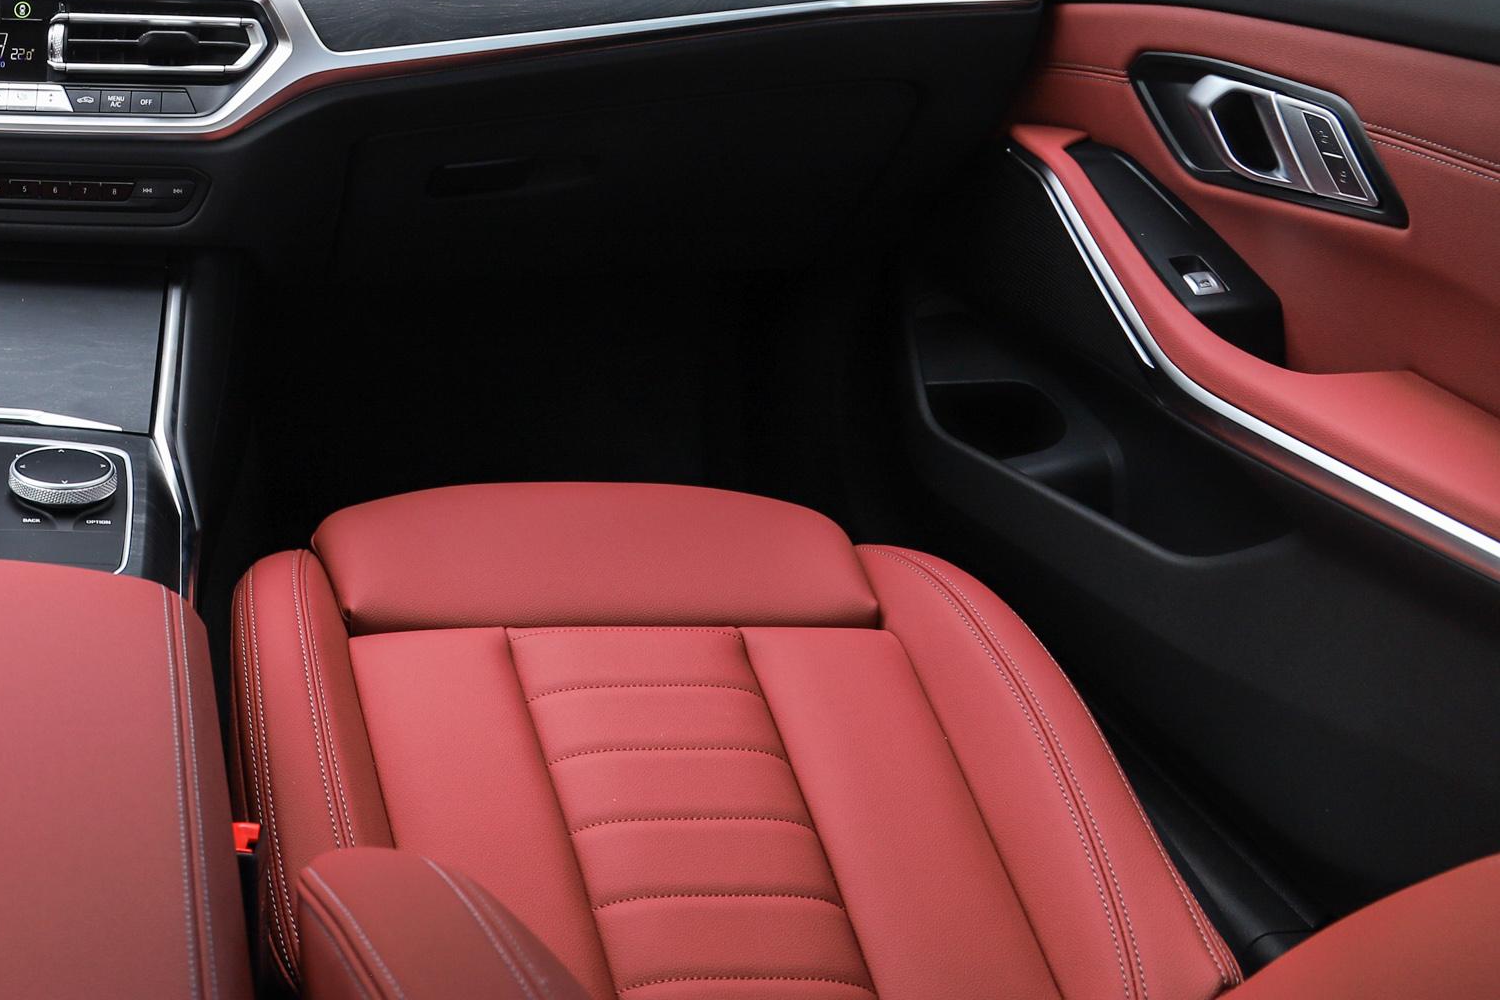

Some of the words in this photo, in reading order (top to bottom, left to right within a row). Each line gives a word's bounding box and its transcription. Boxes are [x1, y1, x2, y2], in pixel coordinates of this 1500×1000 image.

[139, 98, 153, 106] OFF
[22, 185, 27, 193] 5
[53, 186, 58, 194] 6
[83, 187, 88, 195] 7
[112, 188, 117, 196] 8
